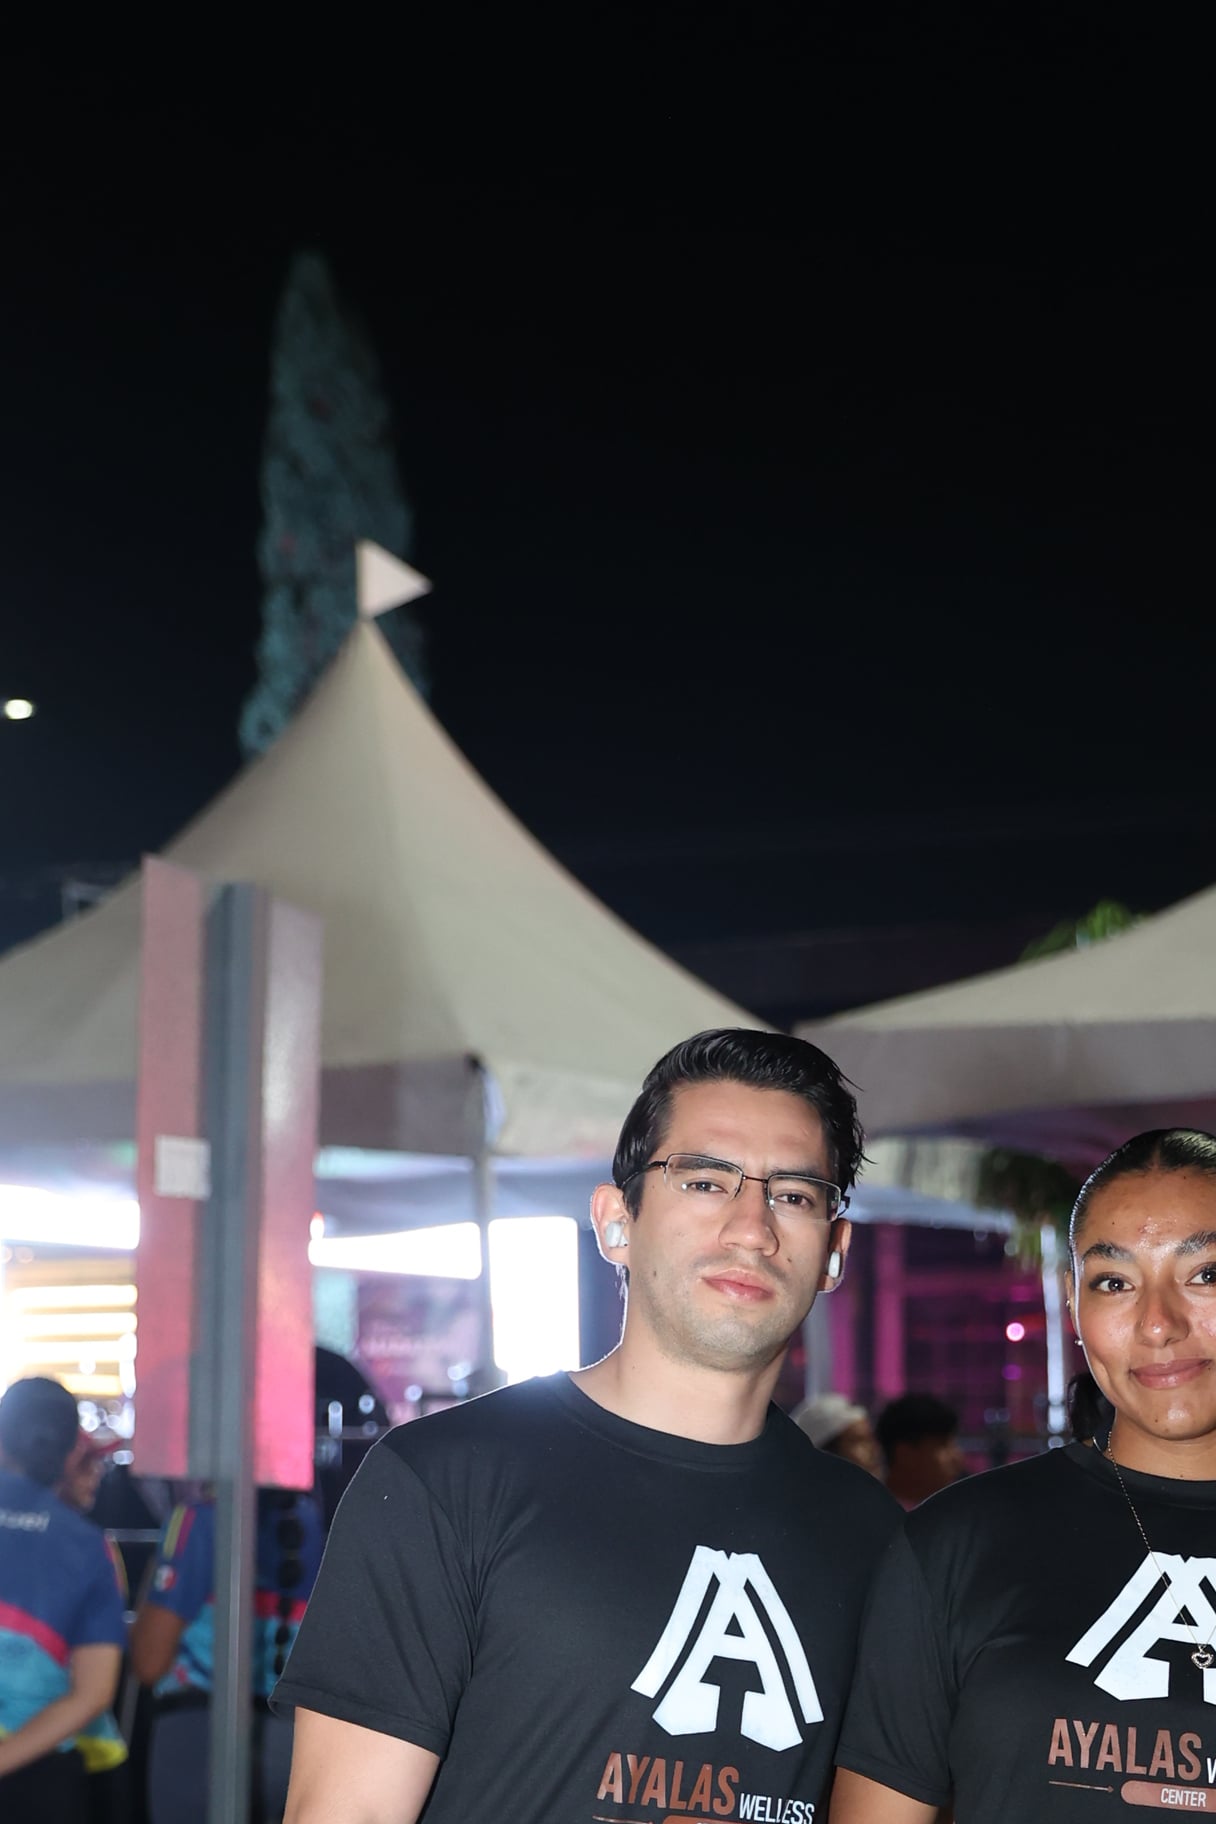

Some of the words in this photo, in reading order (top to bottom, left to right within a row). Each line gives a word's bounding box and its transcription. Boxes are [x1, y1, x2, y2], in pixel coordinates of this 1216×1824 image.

[1047, 1718, 1203, 1781] AYALAS
[596, 1751, 740, 1815] AYALAS
[1160, 1788, 1206, 1807] CENTER
